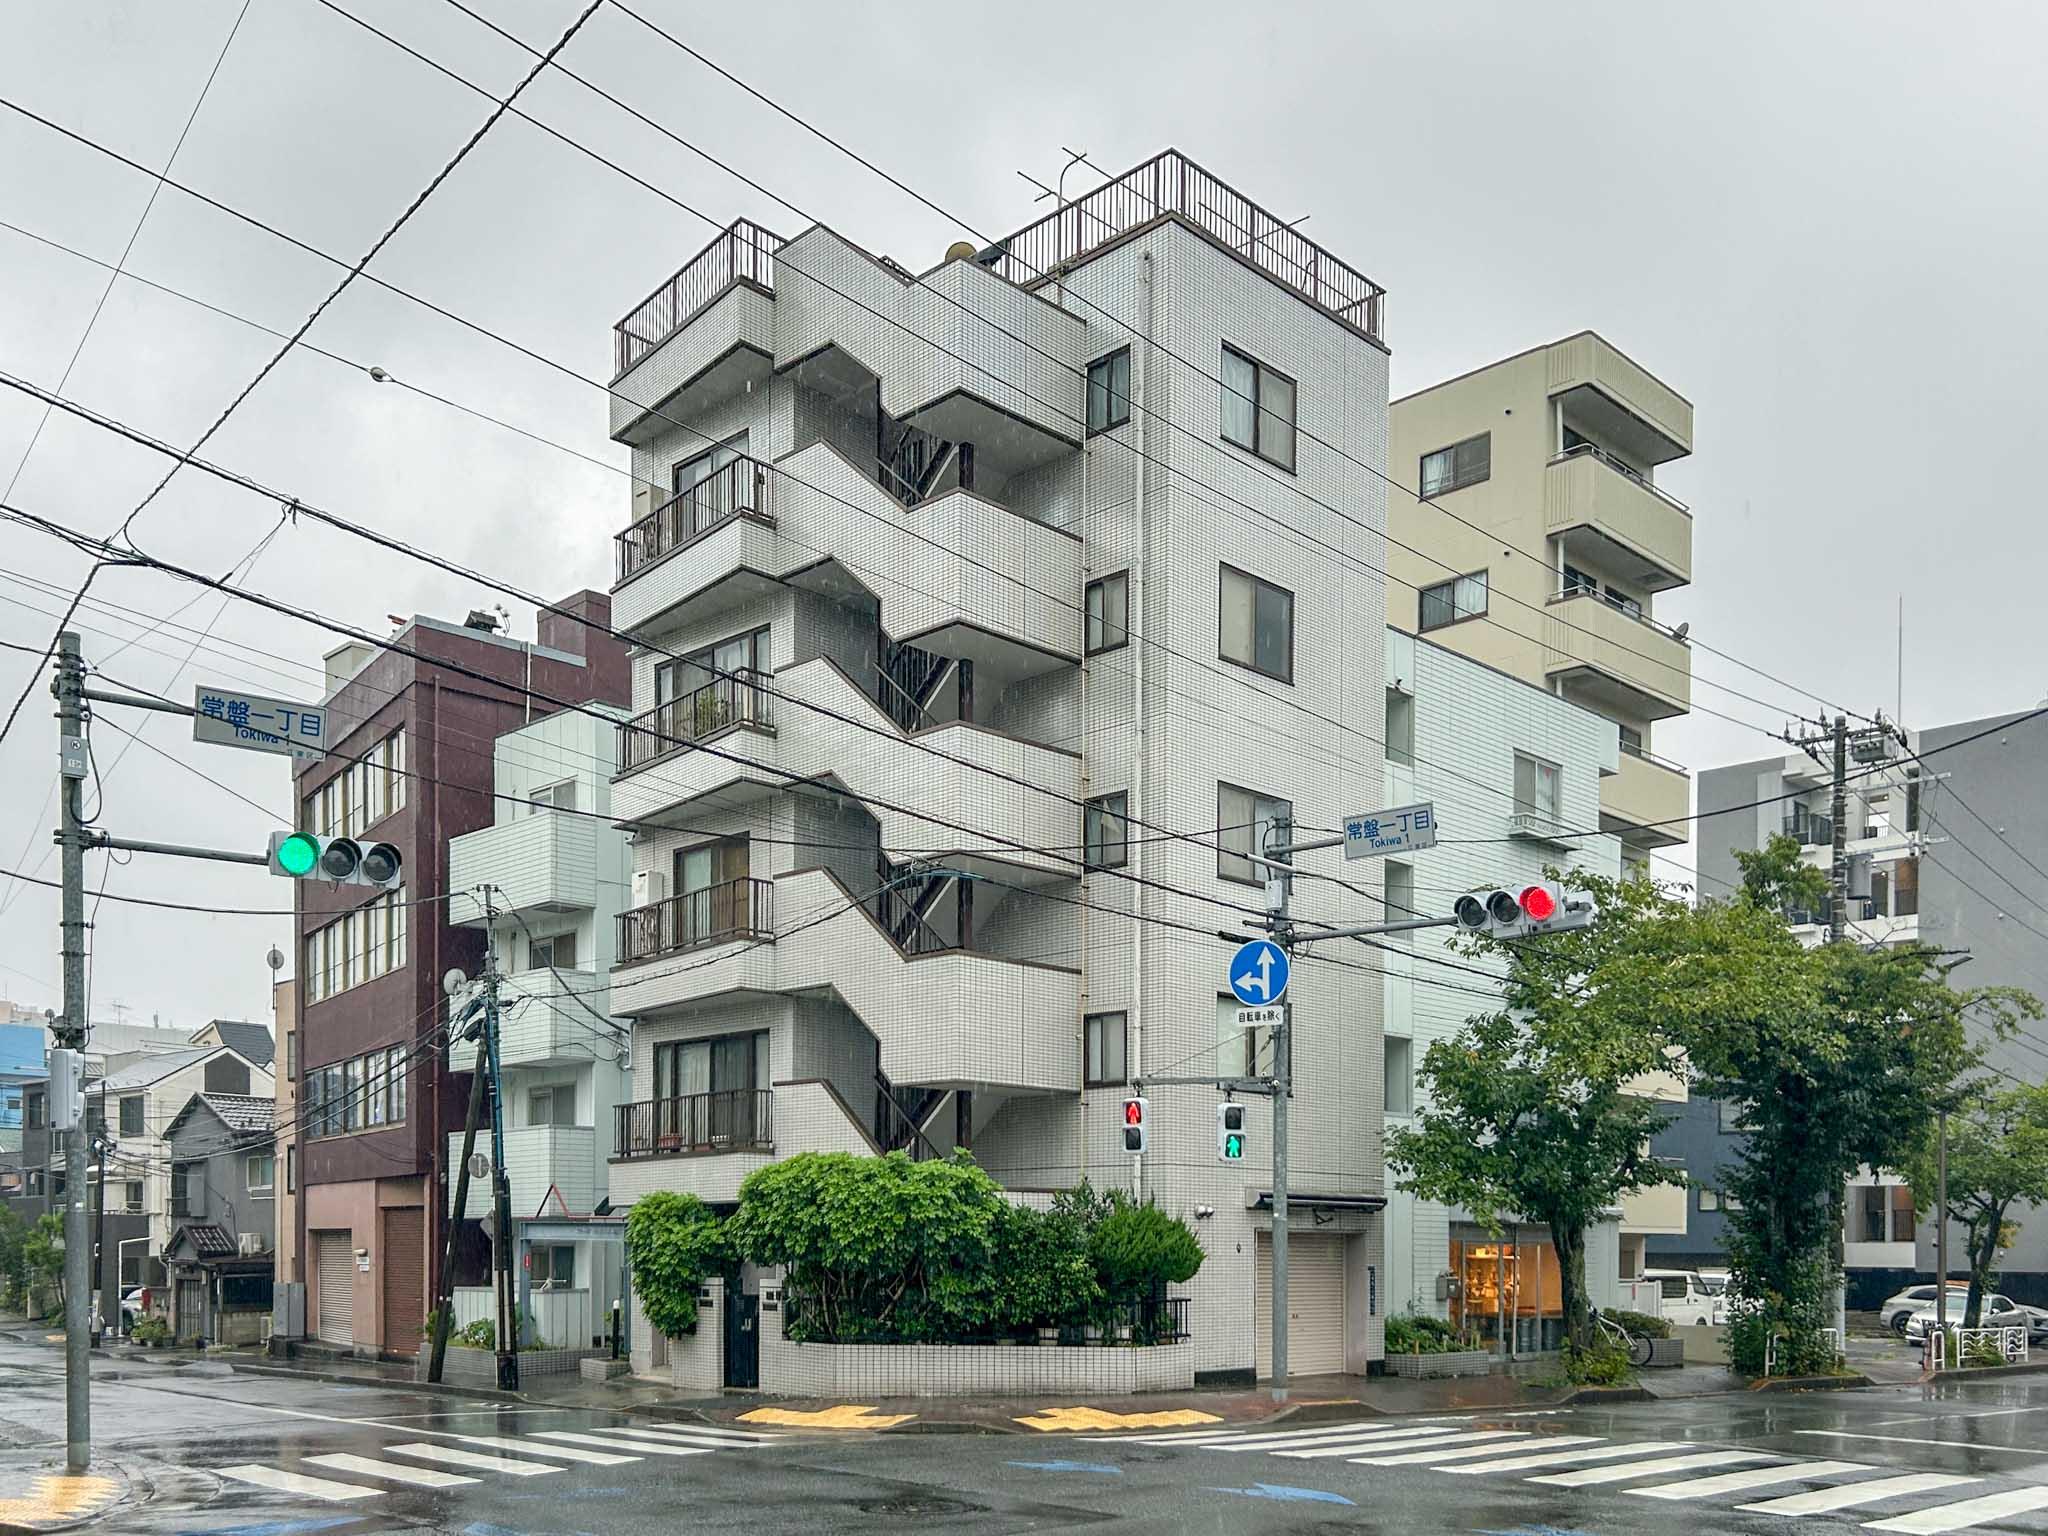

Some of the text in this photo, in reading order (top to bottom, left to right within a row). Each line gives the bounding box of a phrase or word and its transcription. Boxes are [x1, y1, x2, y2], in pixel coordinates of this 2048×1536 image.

[202, 695, 320, 737] 常盤一丁目
[233, 725, 279, 744] Tokiwa
[1347, 810, 1429, 841] 常盤一丁目
[1369, 835, 1402, 849] Tokiwa
